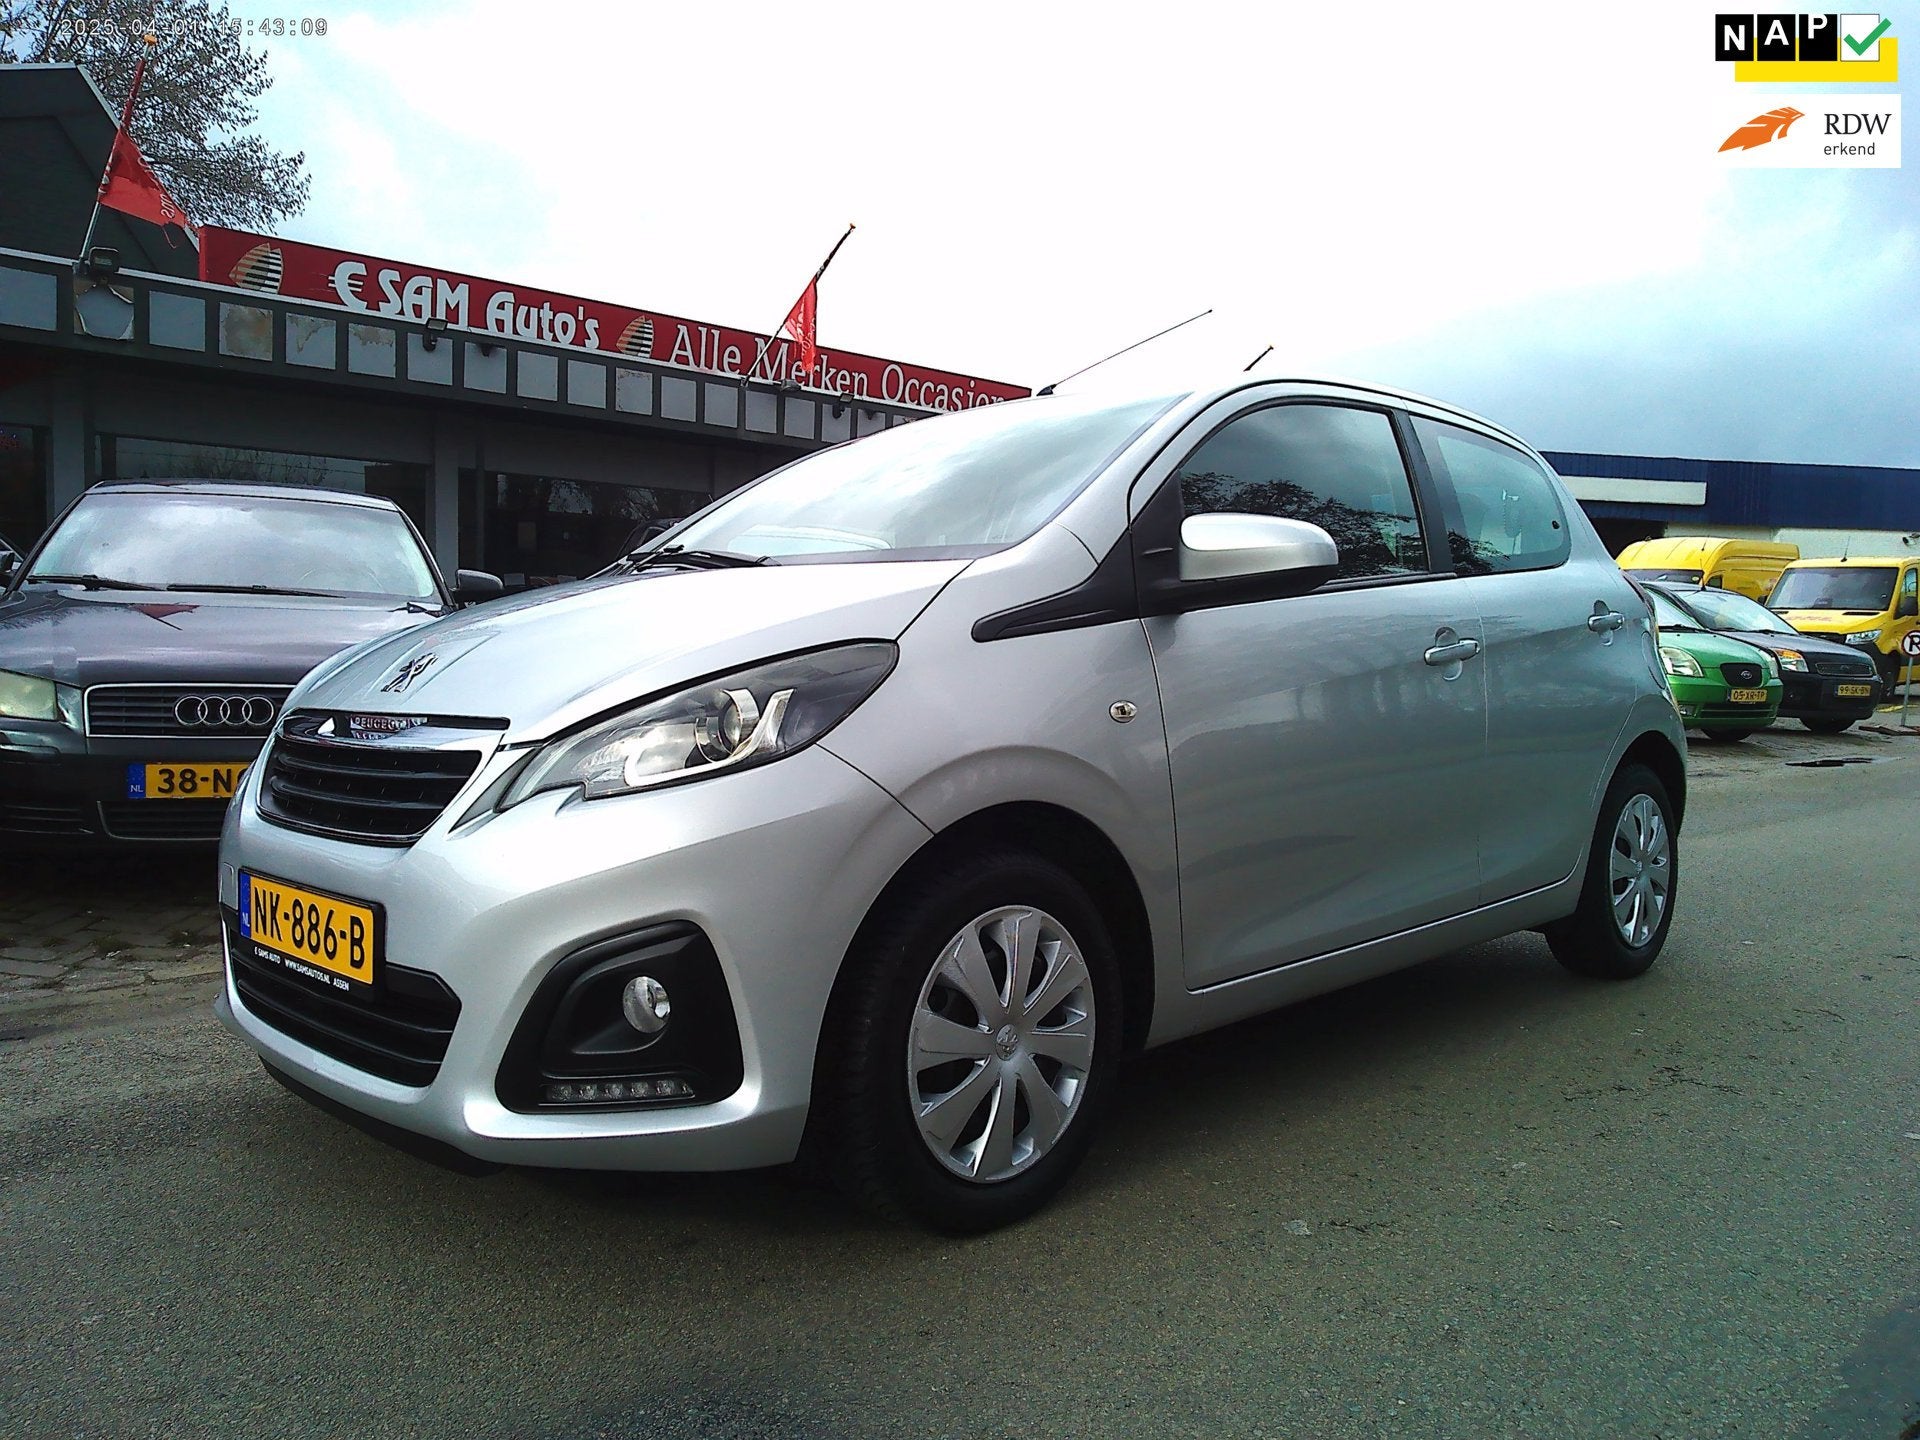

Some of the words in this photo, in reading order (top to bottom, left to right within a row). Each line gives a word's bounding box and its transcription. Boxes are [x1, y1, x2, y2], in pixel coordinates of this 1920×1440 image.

[486, 291, 600, 350] Auto's
[668, 324, 742, 375] Alle
[754, 337, 869, 399] Merken
[130, 785, 144, 793] NL
[242, 911, 250, 928] NL
[254, 886, 365, 969] NK-886-B
[333, 977, 350, 991] ASSEN
